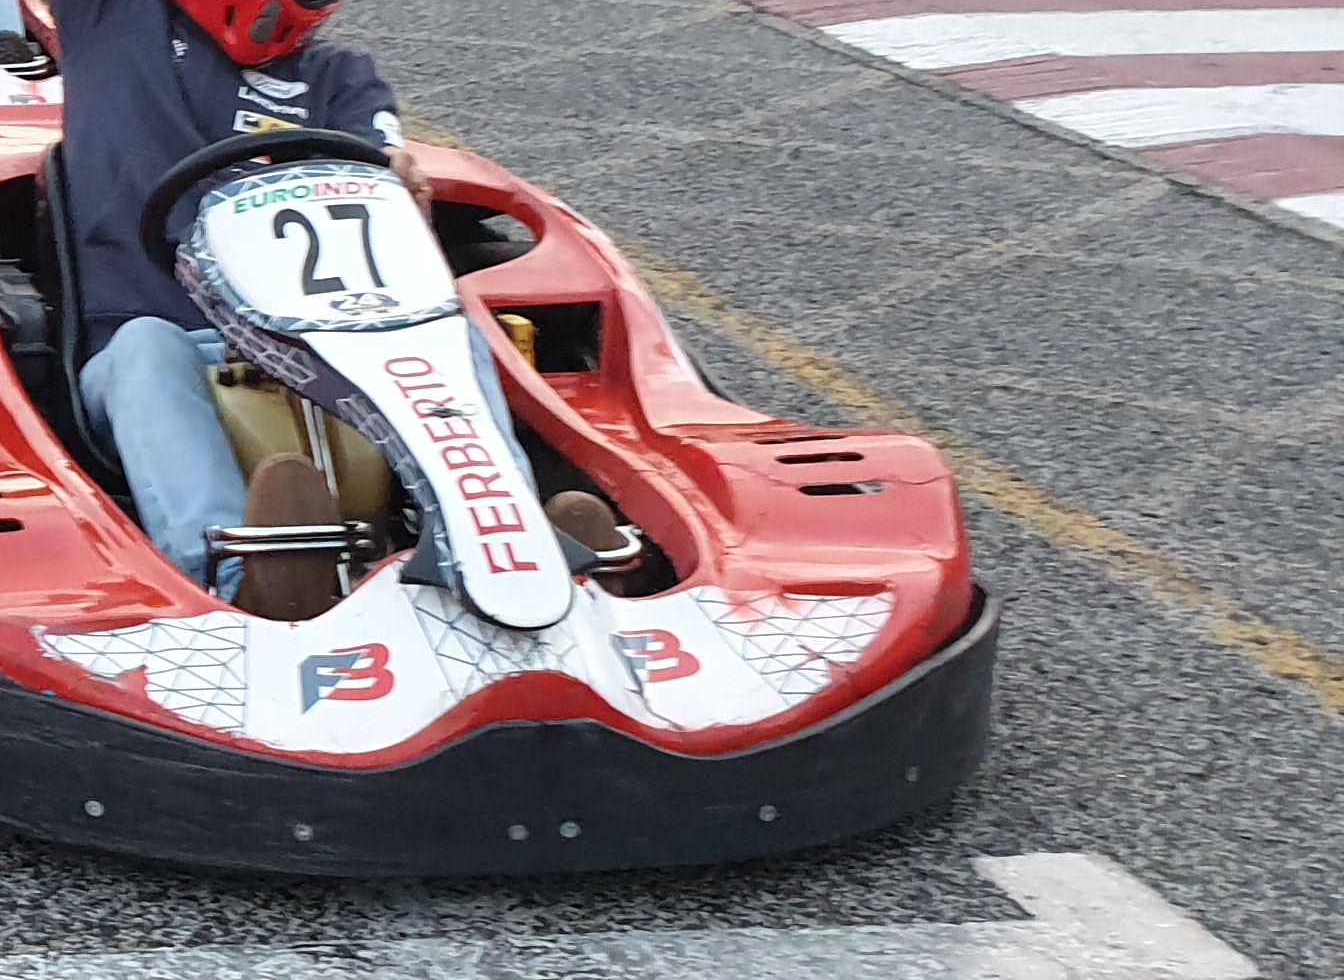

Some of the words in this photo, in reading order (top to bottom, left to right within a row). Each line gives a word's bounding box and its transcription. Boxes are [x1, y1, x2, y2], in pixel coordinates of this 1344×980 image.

[233, 181, 381, 215] EUROINDY
[272, 203, 388, 296] 27
[382, 356, 542, 576] FERBERTO
